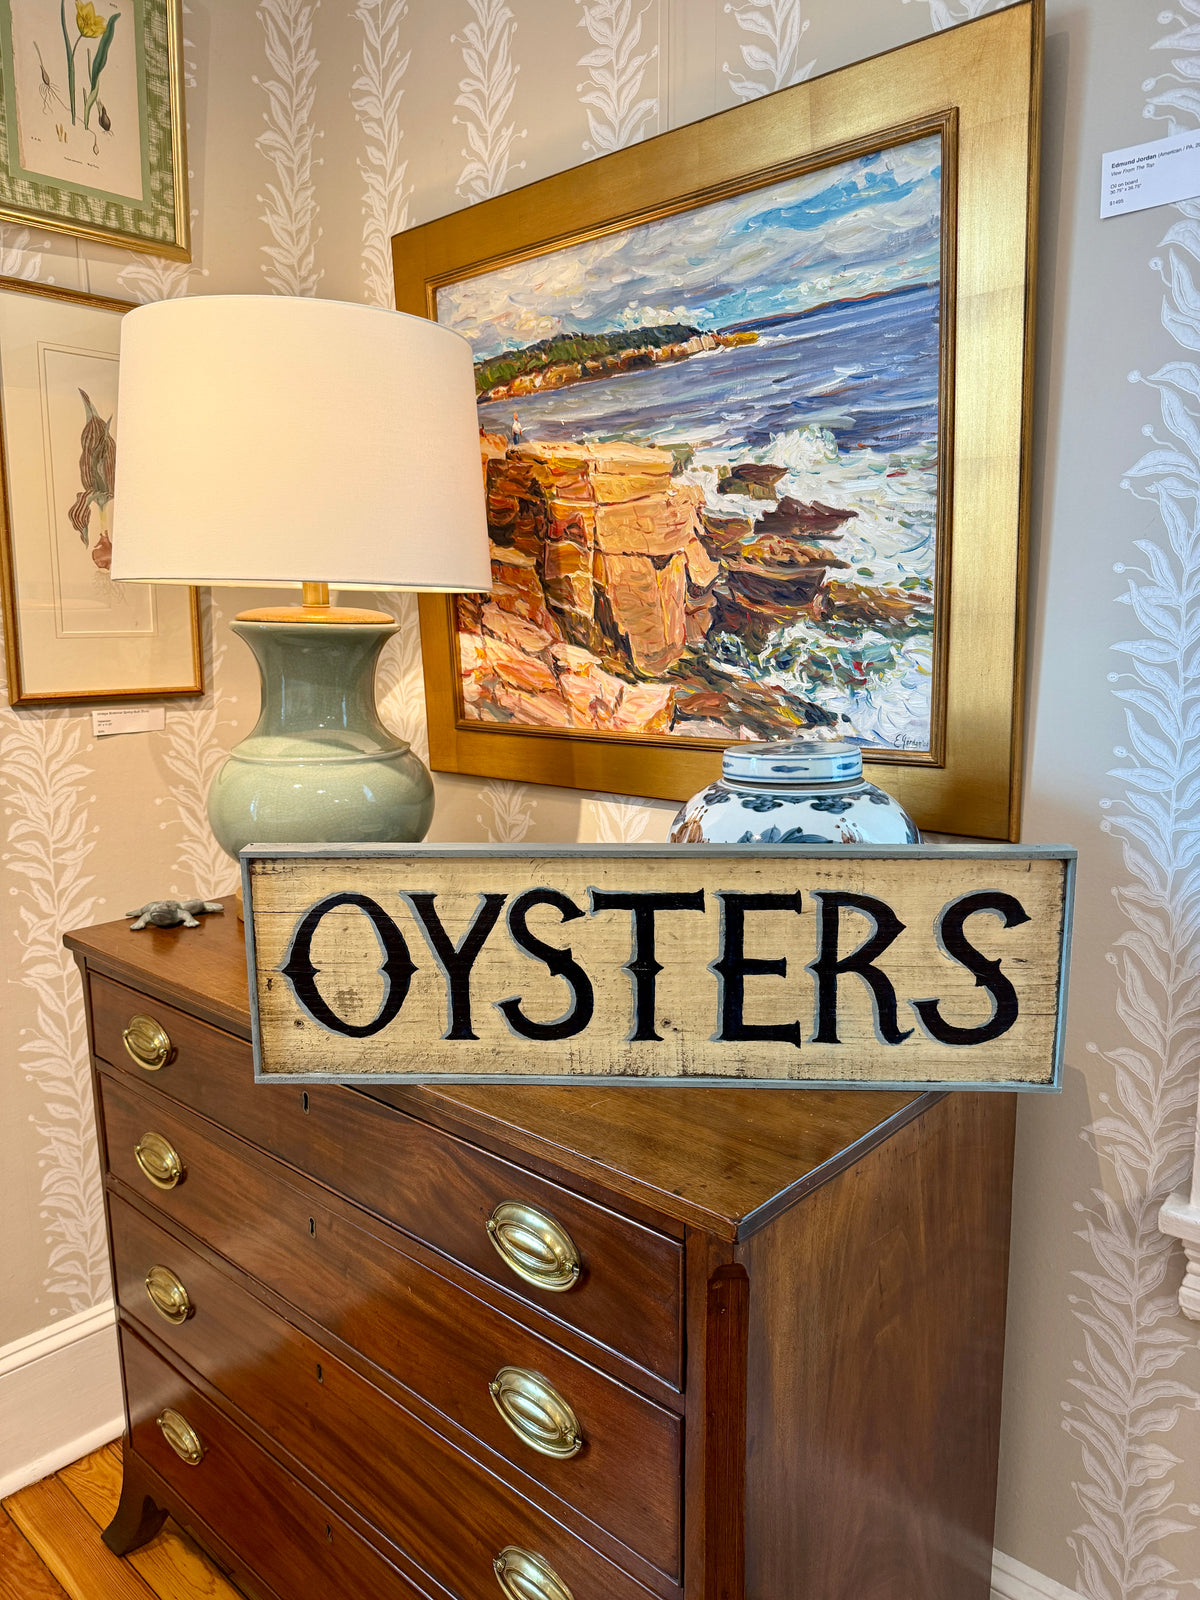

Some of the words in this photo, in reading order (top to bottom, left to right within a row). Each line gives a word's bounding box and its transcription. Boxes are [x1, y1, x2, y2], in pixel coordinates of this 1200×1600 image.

[1111, 158, 1136, 169] Edmund
[1136, 154, 1157, 163] Jordan
[1157, 147, 1182, 159] (American
[280, 886, 1032, 1047] OYSTERS
